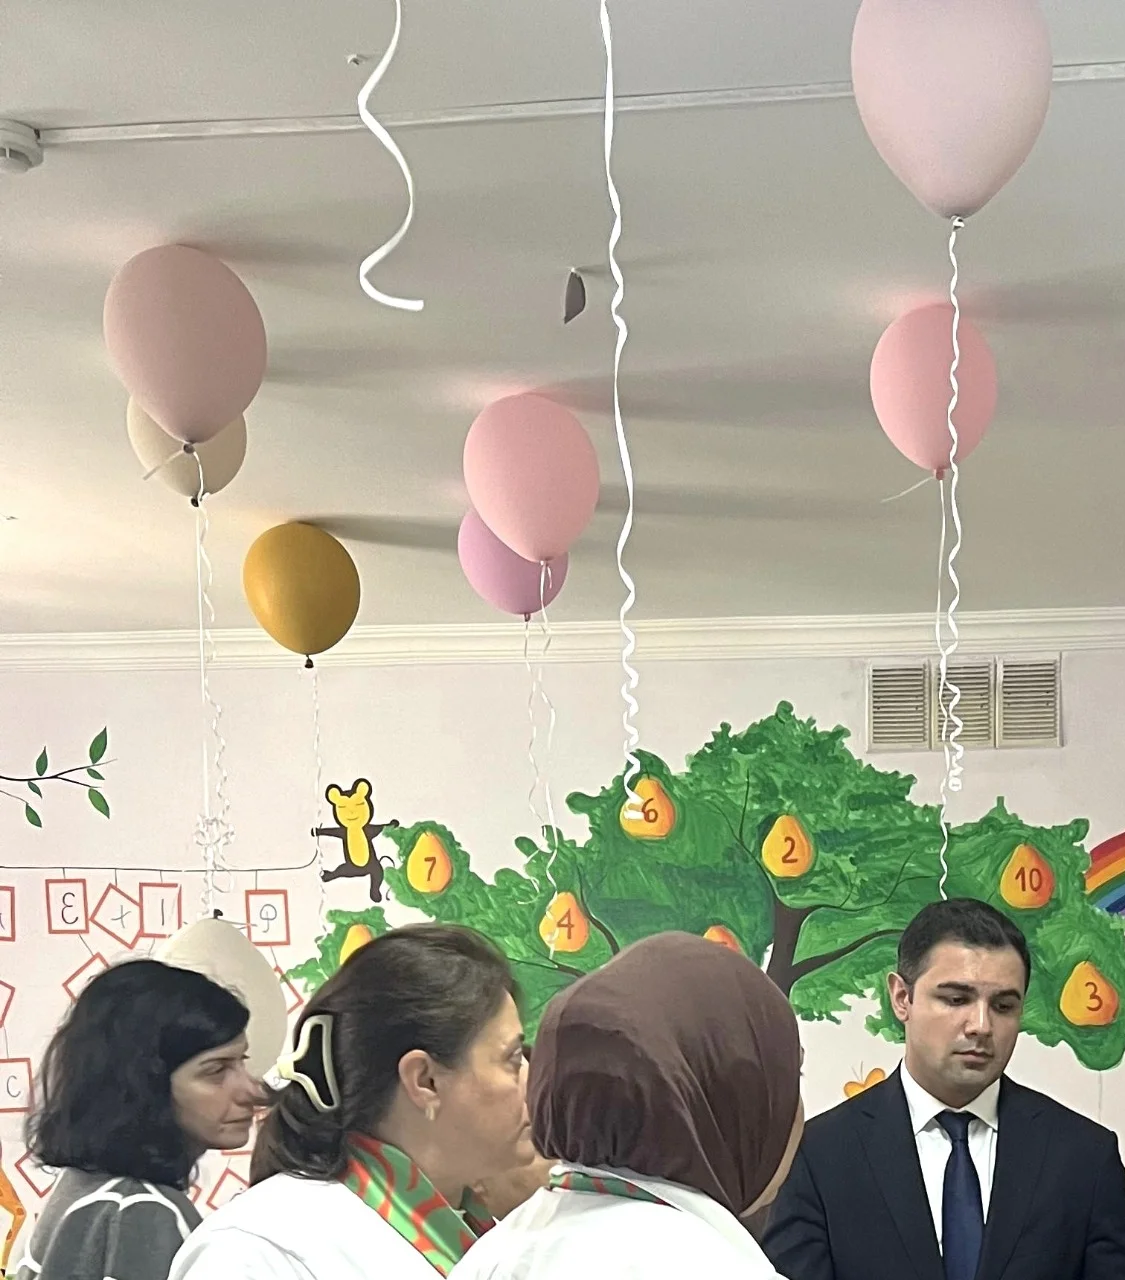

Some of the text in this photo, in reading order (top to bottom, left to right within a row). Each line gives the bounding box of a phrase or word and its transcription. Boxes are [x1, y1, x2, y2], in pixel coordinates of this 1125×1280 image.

[641, 797, 658, 823] 6
[781, 836, 798, 864] 2
[424, 856, 437, 882] 7
[1015, 866, 1042, 892] 10
[556, 908, 575, 939] 4
[1085, 981, 1103, 1012] 3
